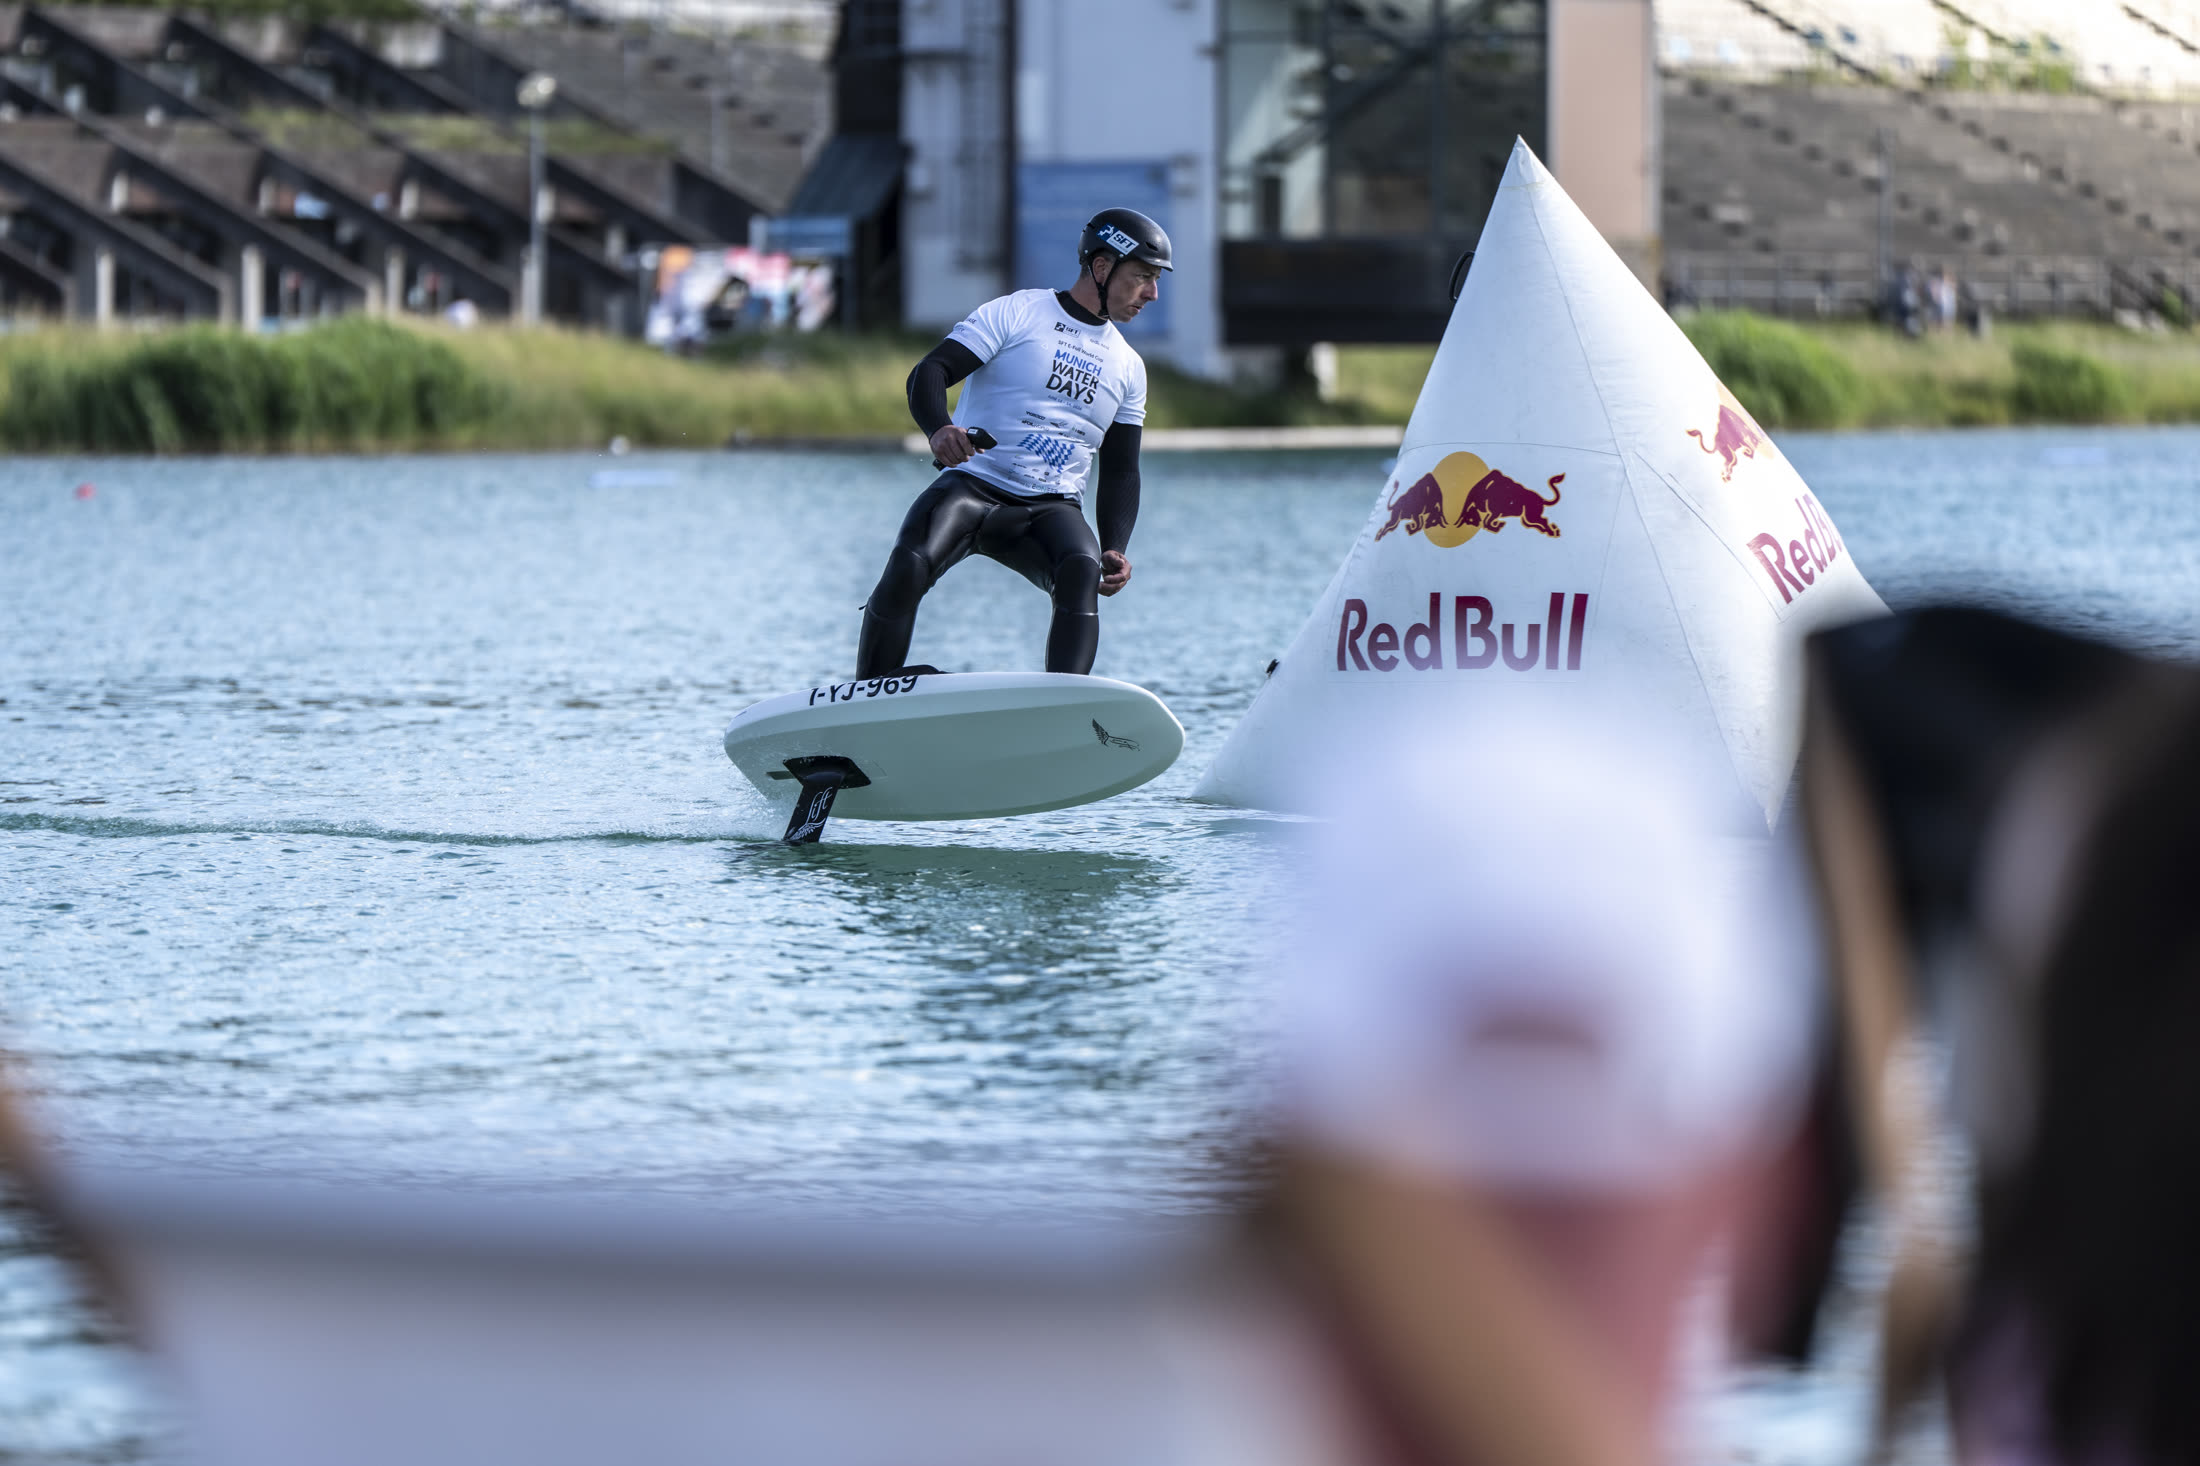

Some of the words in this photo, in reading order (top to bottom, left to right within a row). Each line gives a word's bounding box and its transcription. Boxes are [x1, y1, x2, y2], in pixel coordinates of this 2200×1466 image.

[1113, 233, 1136, 249] SFT
[1054, 349, 1102, 377] MUNICH
[1081, 349, 1095, 359] World
[1095, 355, 1104, 363] Cup
[1045, 373, 1097, 405] DAYS
[1052, 360, 1099, 390] WATER
[1747, 498, 1828, 604] Red
[1336, 591, 1442, 672] Red
[1454, 591, 1589, 672] Bull
